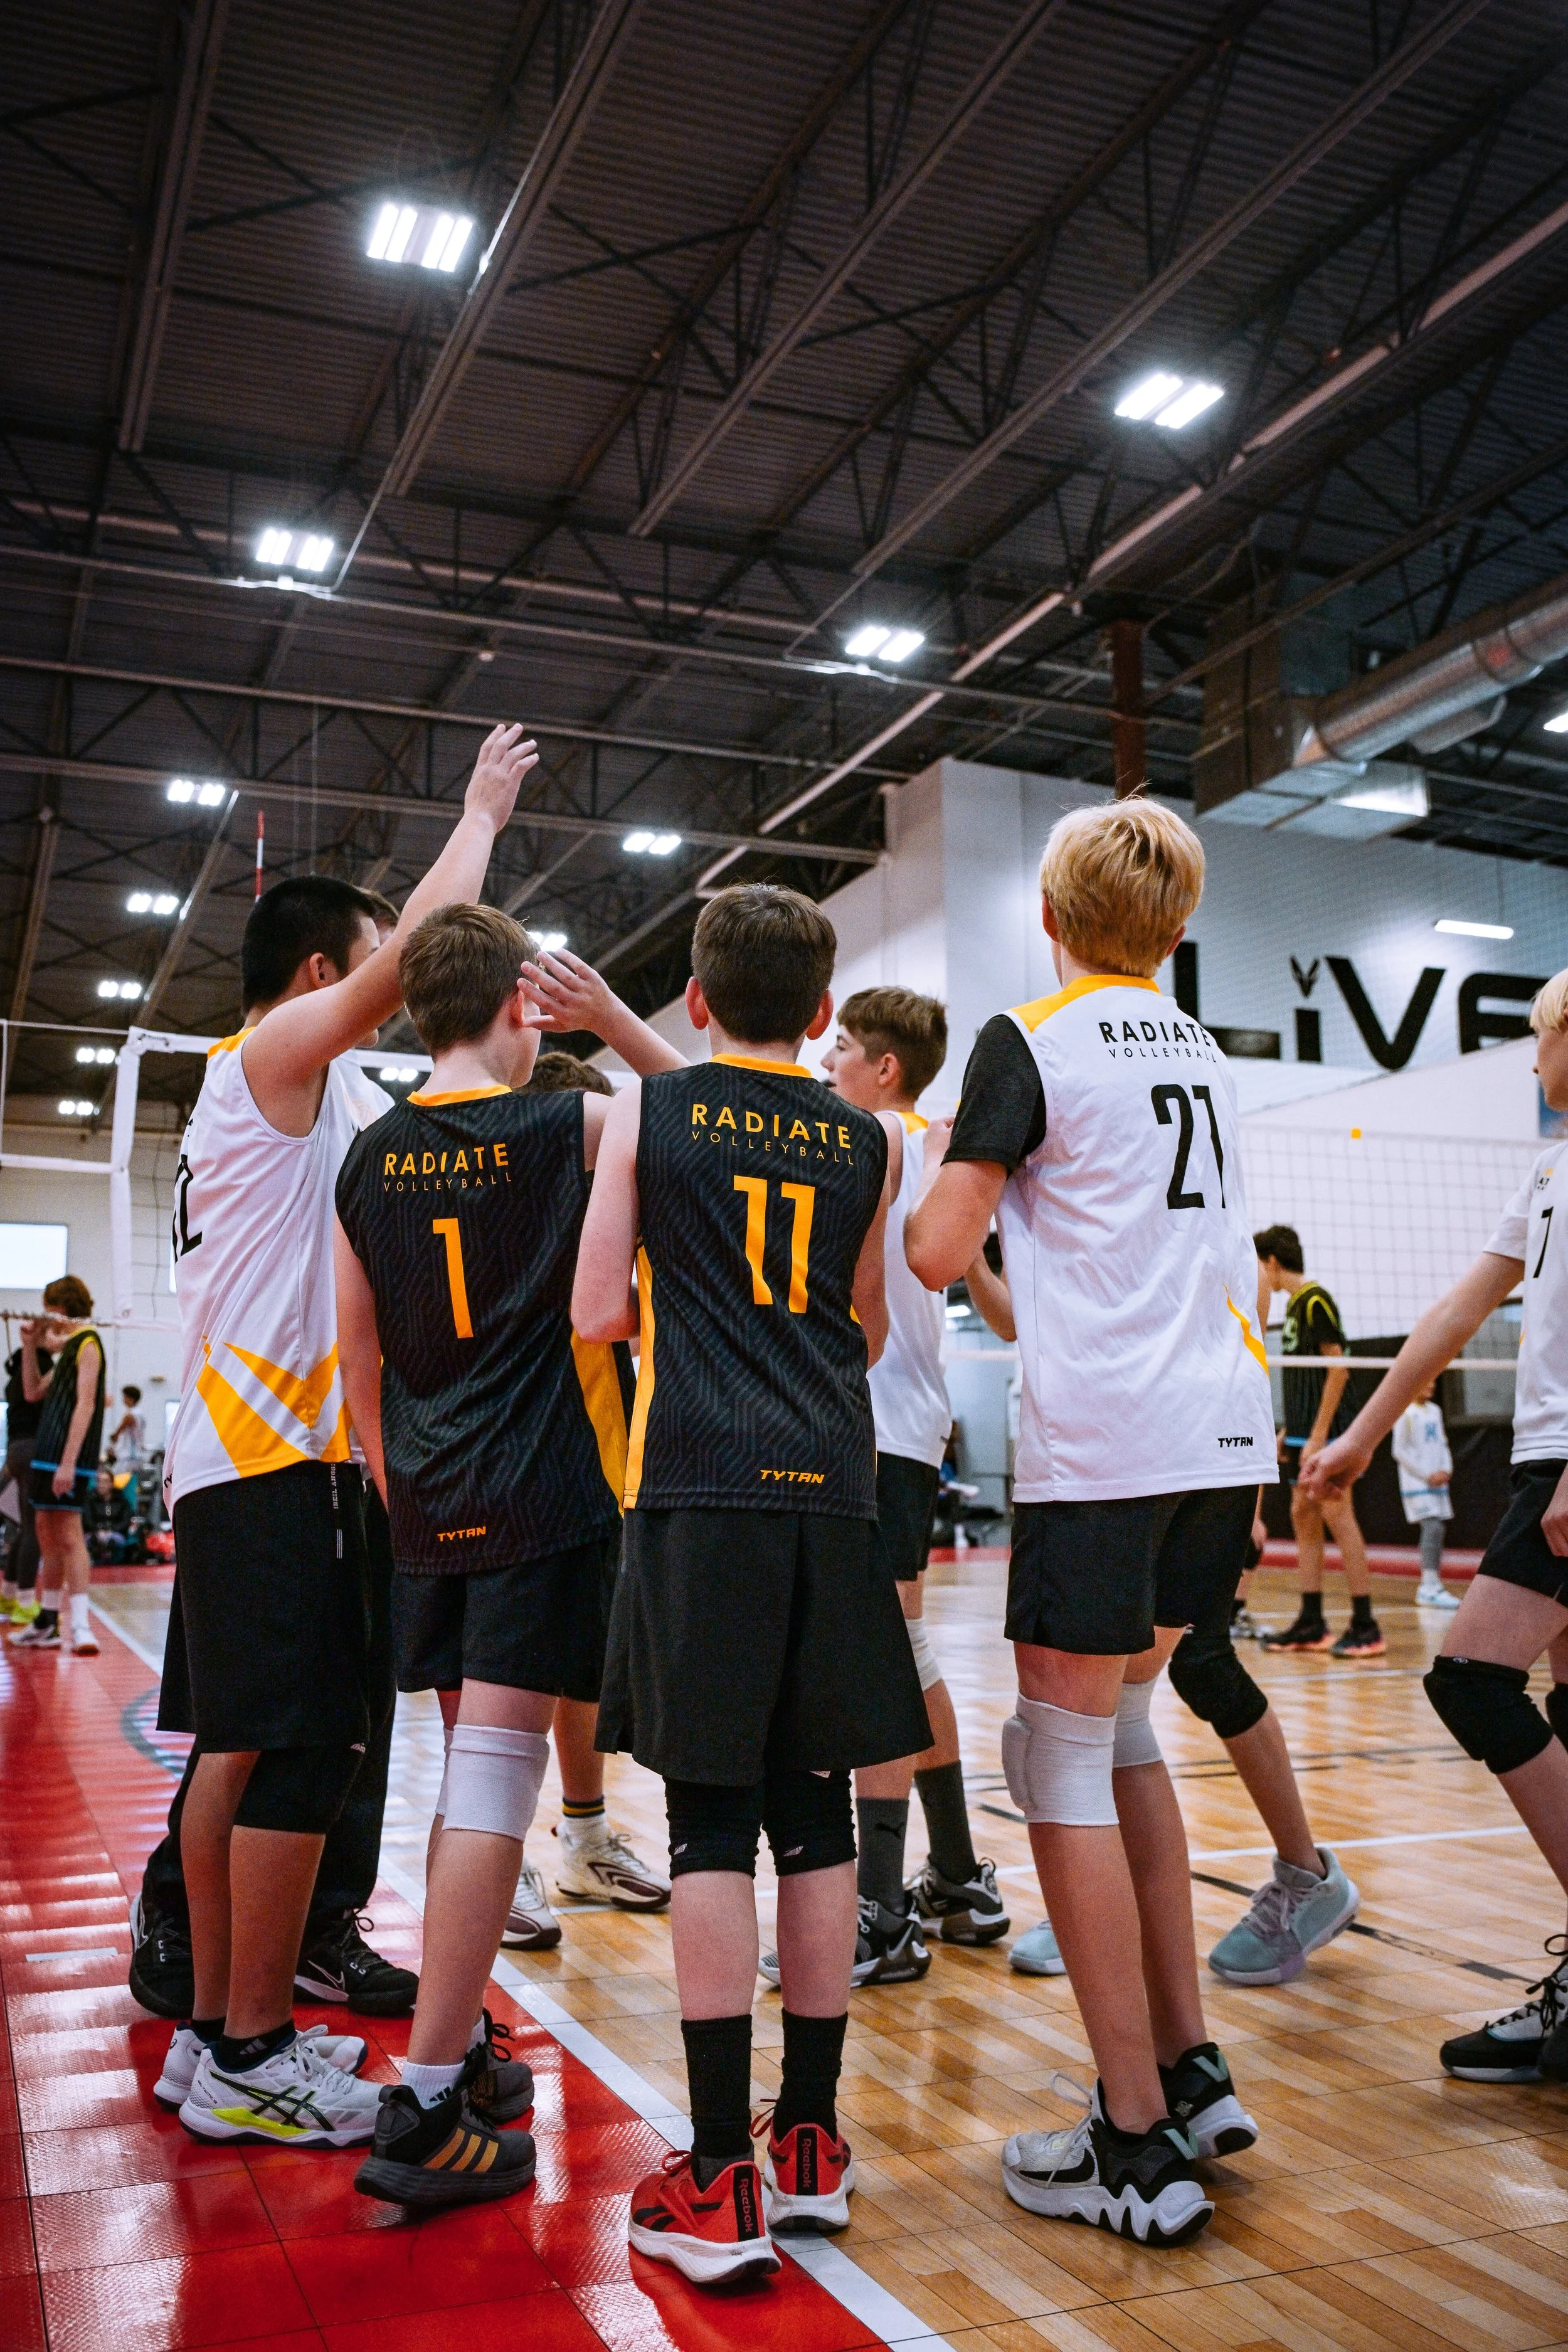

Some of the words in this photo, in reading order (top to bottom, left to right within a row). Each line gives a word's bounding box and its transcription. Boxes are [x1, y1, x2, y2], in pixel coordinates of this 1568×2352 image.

[1098, 1021, 1210, 1047] RADIATE
[1108, 1047, 1217, 1062] VOLLEYBALL
[692, 1103, 851, 1149] RADIATE
[384, 1143, 509, 1175] RADIATE
[692, 1131, 854, 1165] VOLLEYBALL
[1151, 1084, 1226, 1210] 21
[384, 1172, 512, 1192] VOLLEYBALL
[733, 1175, 816, 1314] 11
[433, 1217, 474, 1339] 1
[760, 1470, 825, 1485] TYTAN
[437, 1526, 486, 1542] TYTAN
[802, 2138, 812, 2188] Reebok
[739, 2178, 754, 2233] Reebok
